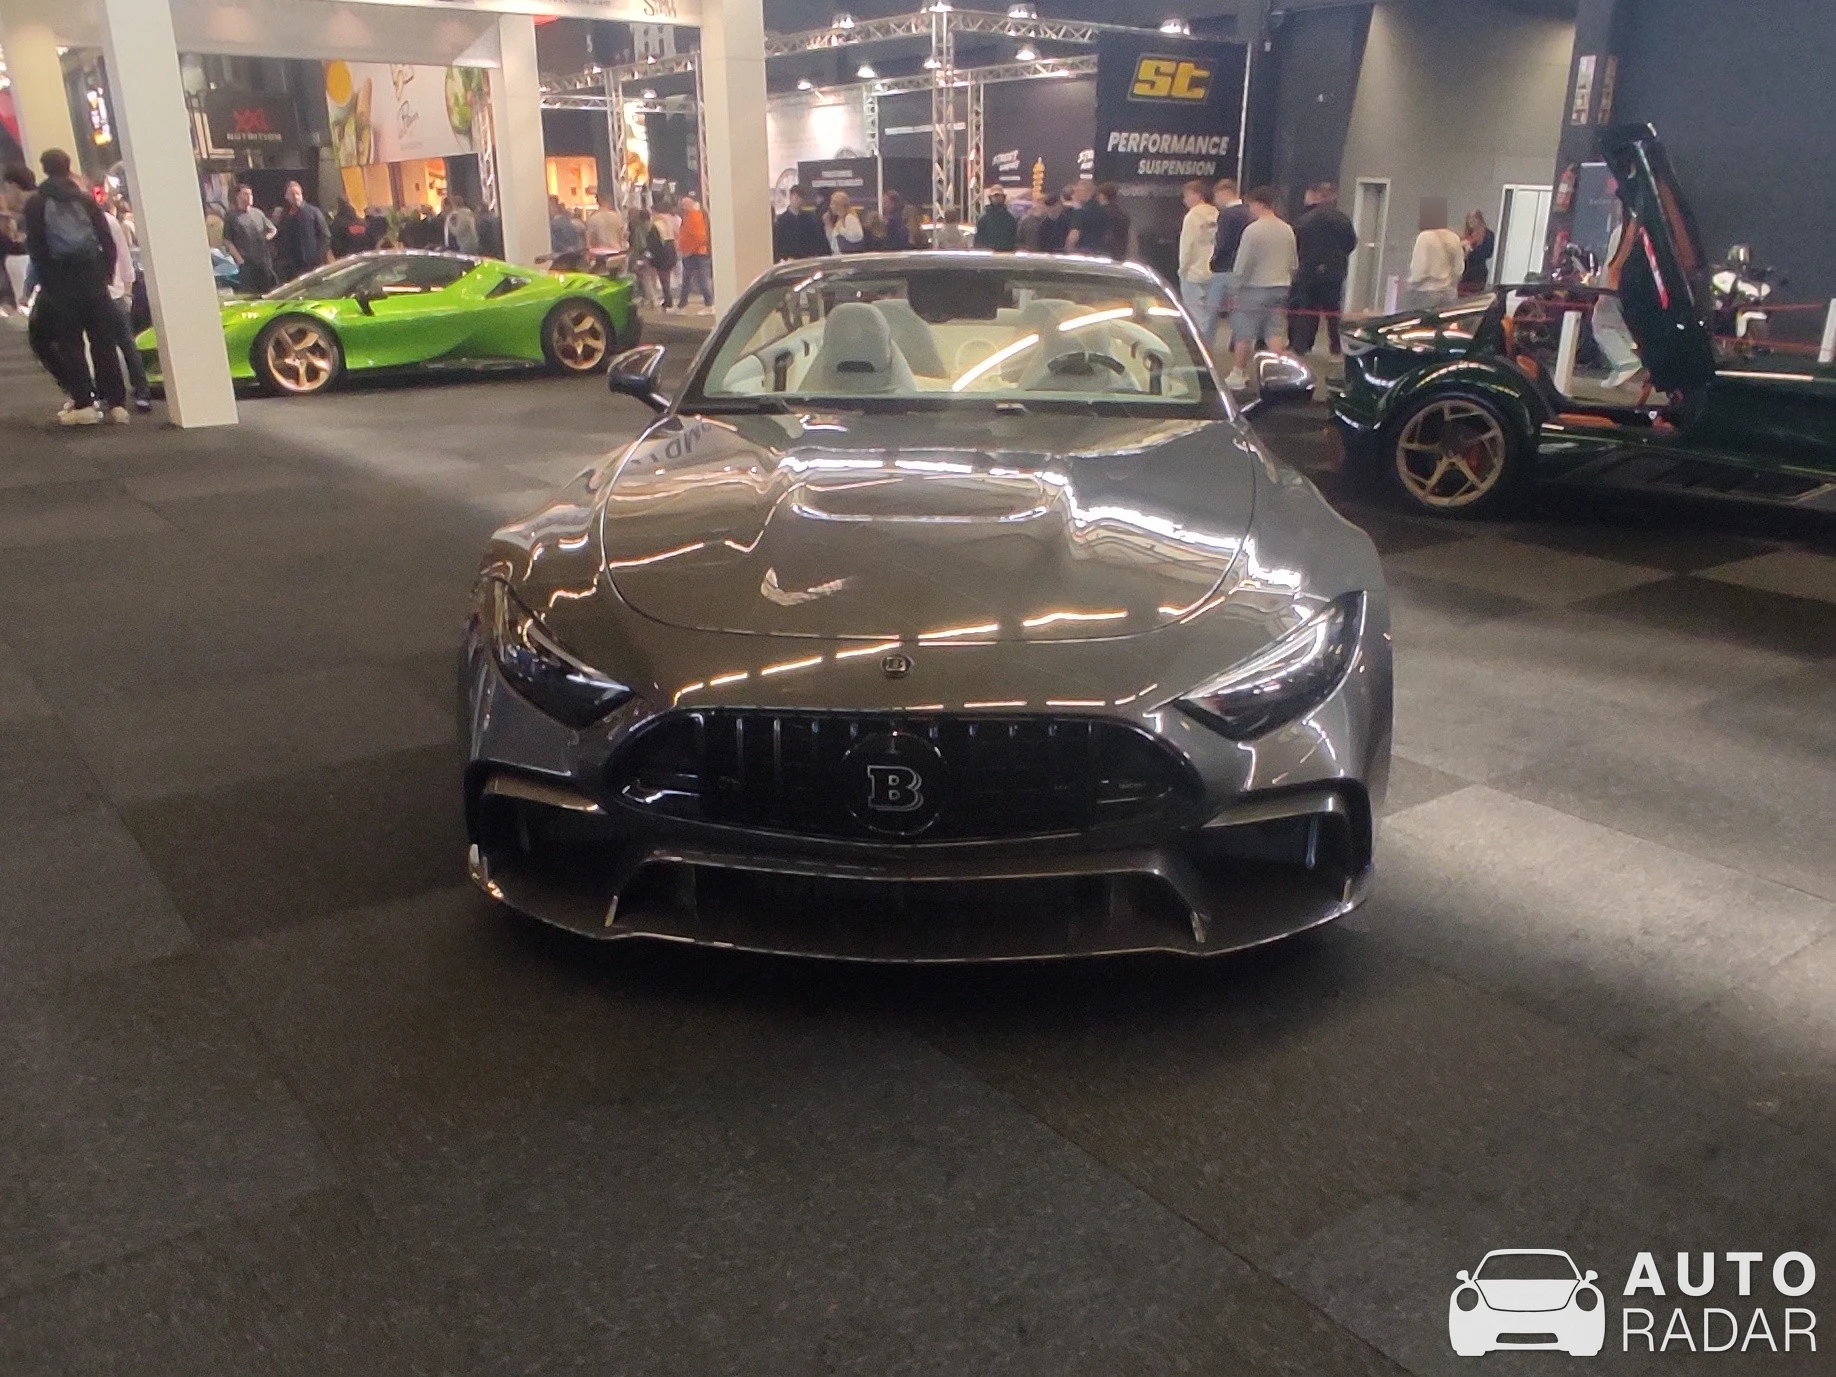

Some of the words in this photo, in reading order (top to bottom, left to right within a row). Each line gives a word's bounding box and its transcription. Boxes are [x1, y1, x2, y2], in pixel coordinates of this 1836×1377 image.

[1107, 132, 1230, 156] PERFORMANCE
[1137, 159, 1217, 176] SUSPENSION
[867, 765, 924, 812] B
